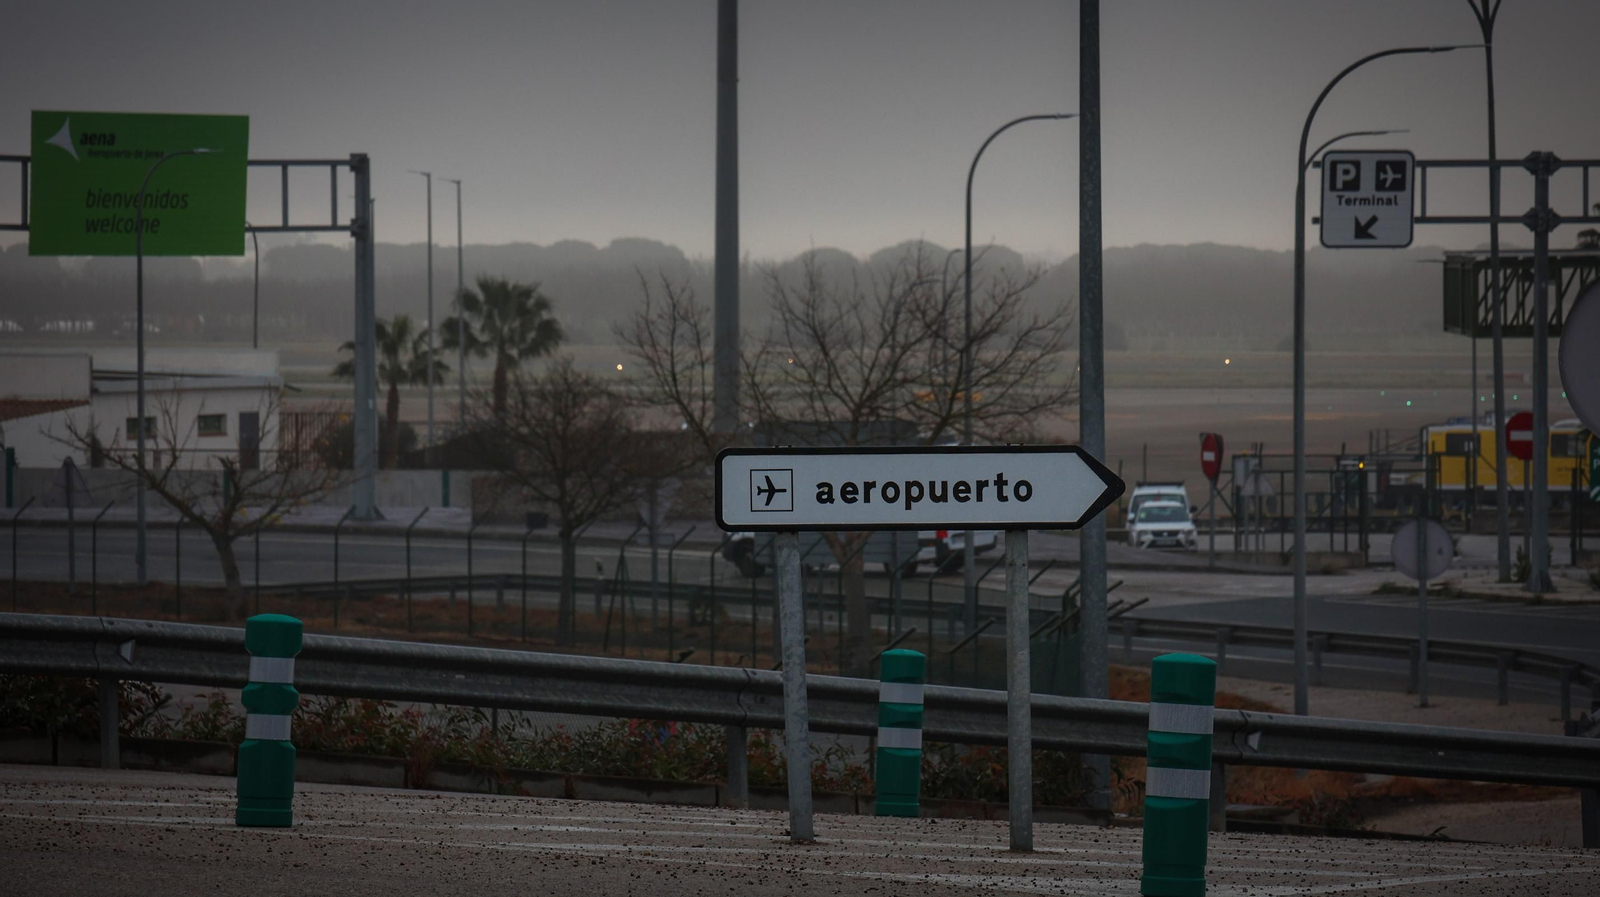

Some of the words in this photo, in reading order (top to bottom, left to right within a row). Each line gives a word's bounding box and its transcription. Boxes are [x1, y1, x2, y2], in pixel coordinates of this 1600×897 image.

[80, 132, 116, 146] aena
[1336, 164, 1357, 189] P
[85, 188, 189, 208] bienvenidos
[1336, 194, 1399, 207] Terminal
[85, 213, 160, 233] welcome
[815, 472, 1033, 511] aeropuerto
